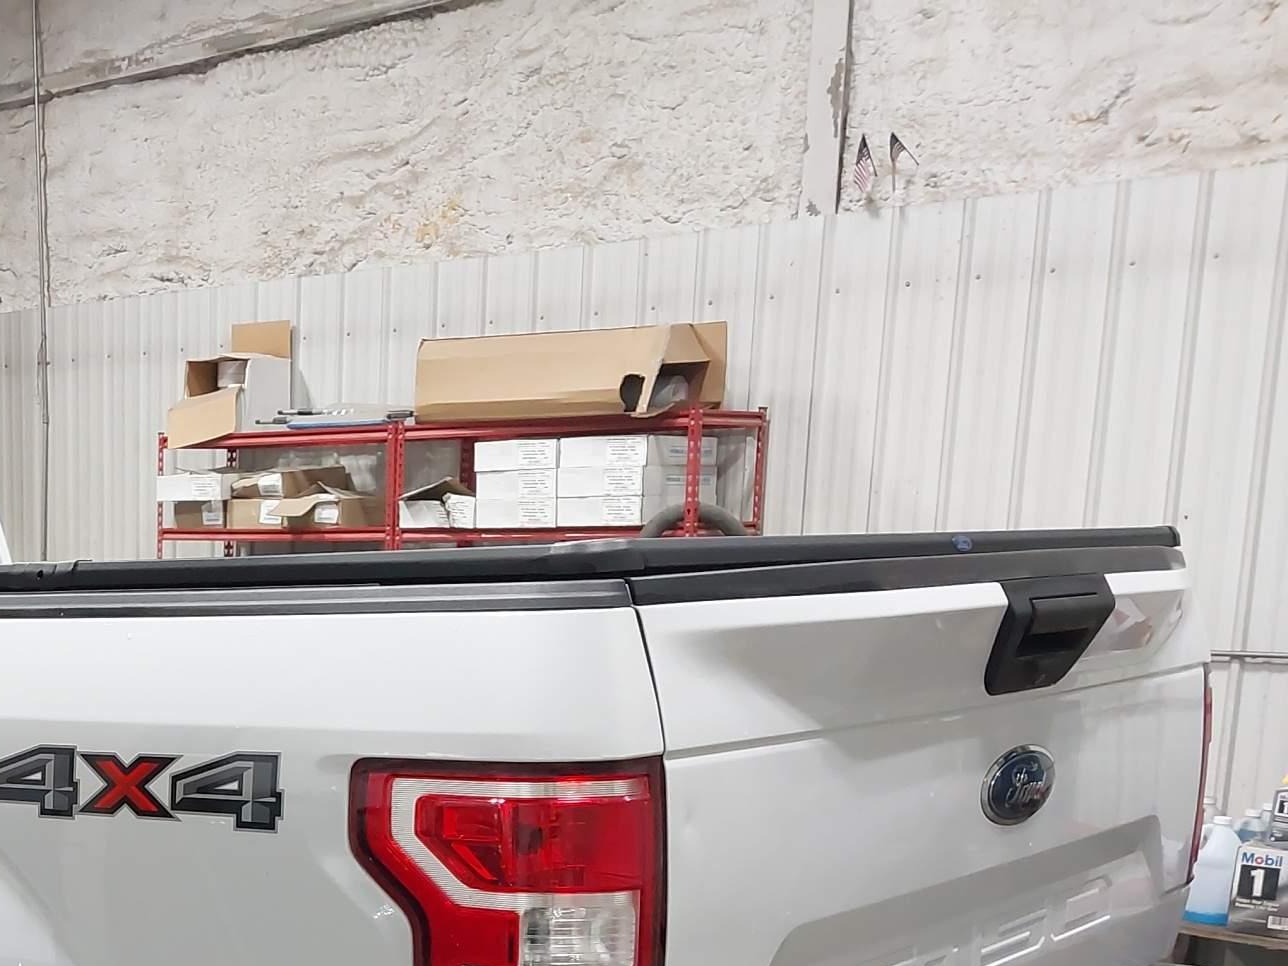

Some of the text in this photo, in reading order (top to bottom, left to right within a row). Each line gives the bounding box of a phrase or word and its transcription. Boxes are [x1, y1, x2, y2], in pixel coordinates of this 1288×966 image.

[1004, 760, 1047, 808] Ford
[1241, 852, 1283, 867] Mobil
[1250, 868, 1265, 897] 1
